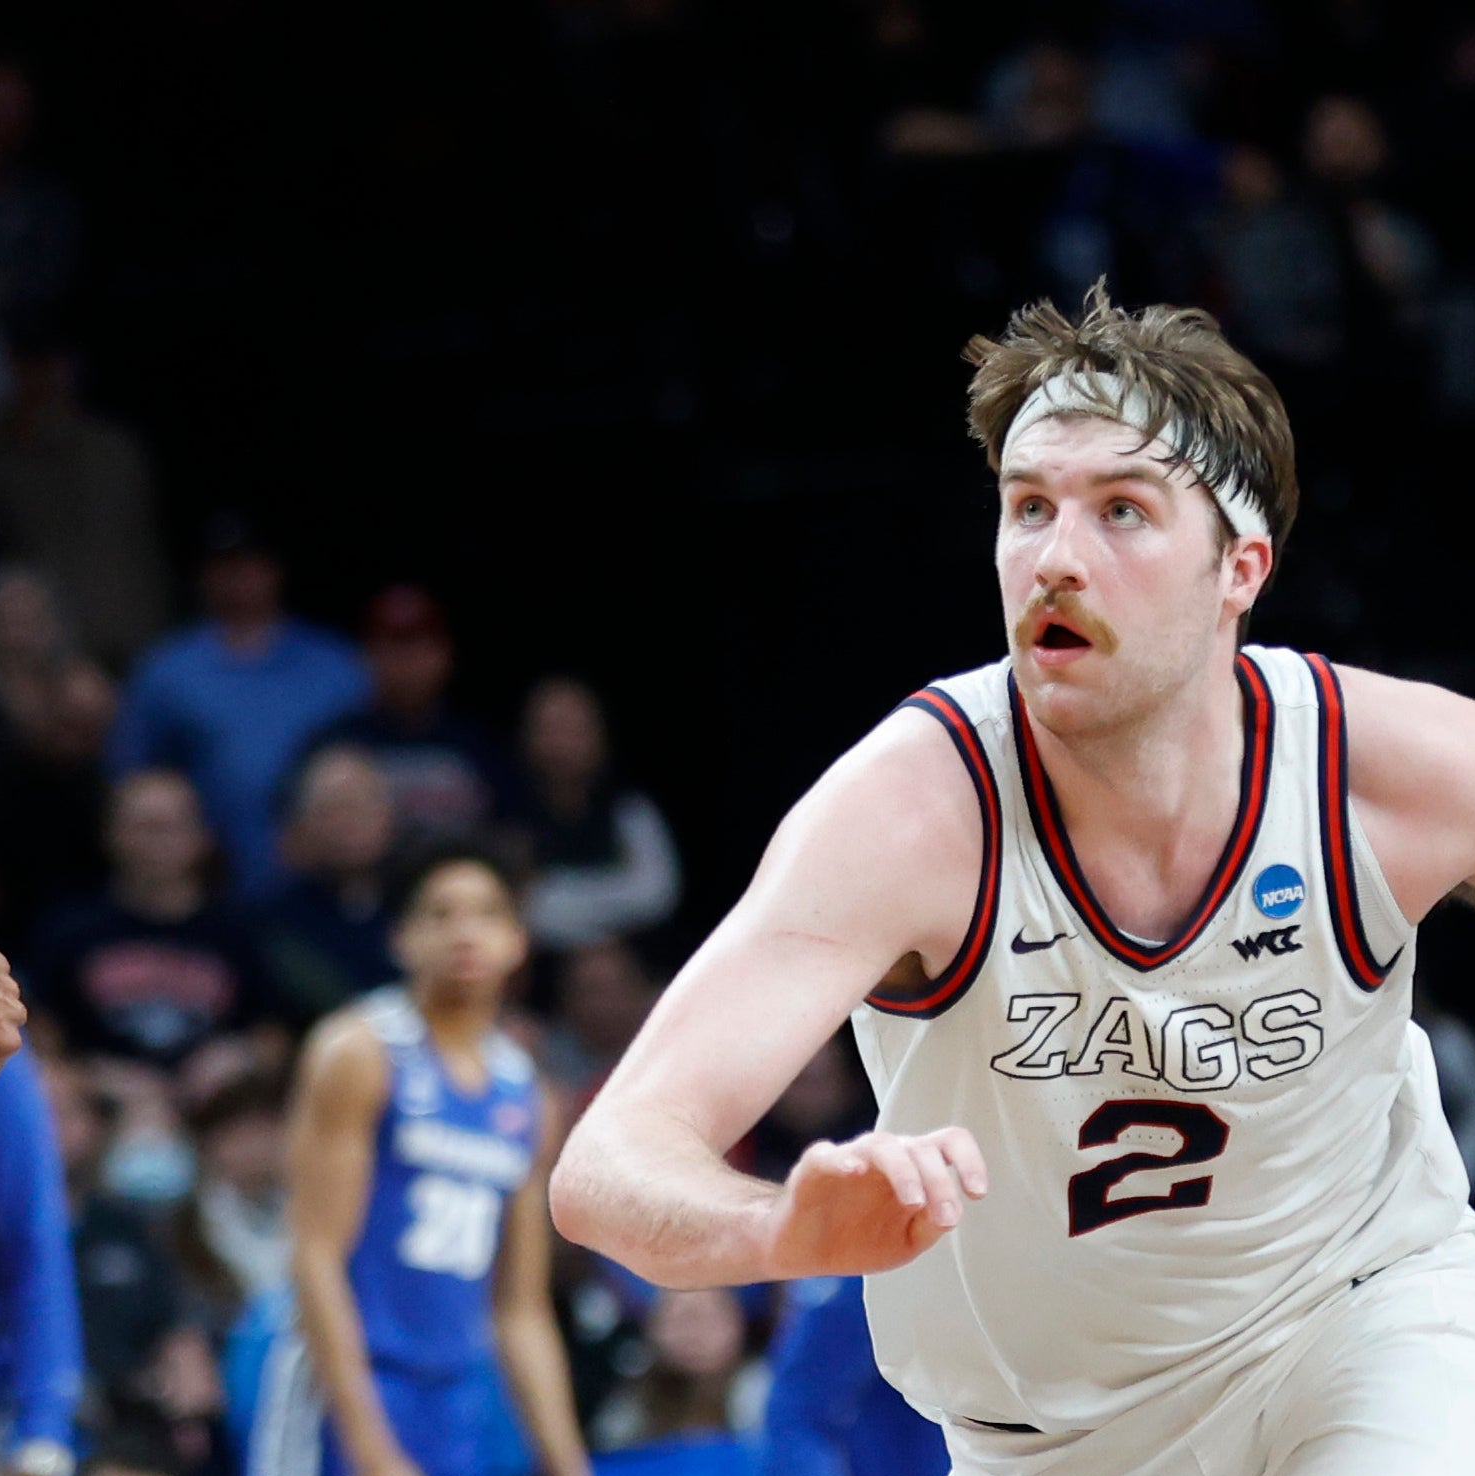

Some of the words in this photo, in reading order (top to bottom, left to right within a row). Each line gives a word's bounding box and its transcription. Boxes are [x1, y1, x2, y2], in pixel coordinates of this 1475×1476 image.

[1262, 885, 1304, 908] NCAA
[990, 988, 1324, 1092] ZAGS
[1068, 1099, 1231, 1238] 2
